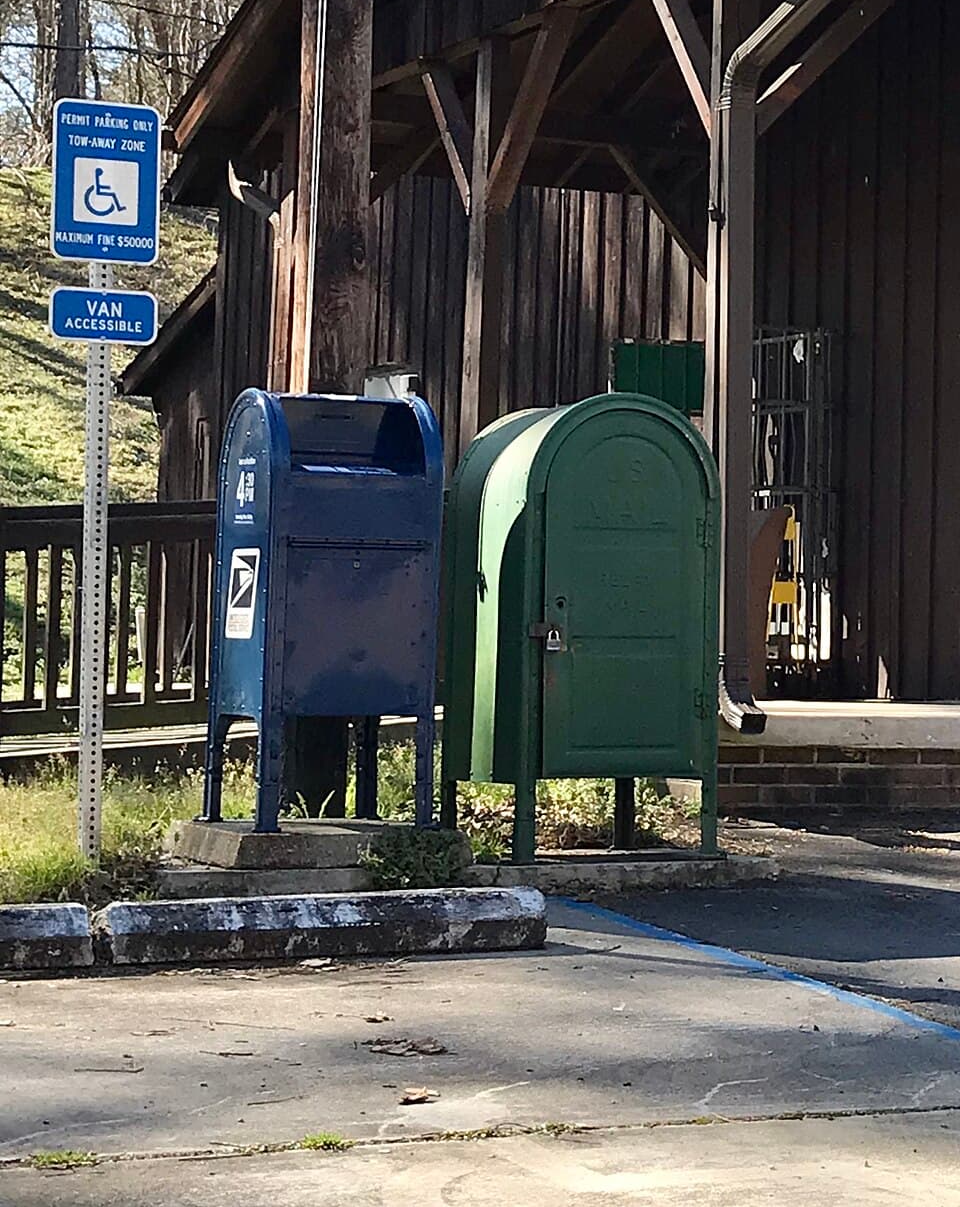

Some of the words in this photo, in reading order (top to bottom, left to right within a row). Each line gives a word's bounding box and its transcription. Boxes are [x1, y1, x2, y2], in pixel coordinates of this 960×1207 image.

[61, 113, 90, 126] PERMIT
[95, 116, 129, 129] PARKING
[133, 120, 154, 132] ONLY
[68, 134, 117, 149] TOW-AWAY
[121, 139, 146, 152] ZONE
[56, 232, 94, 245] MAXIMUM
[97, 234, 116, 246] FINE
[86, 299, 123, 318] VAN
[64, 318, 142, 333] ACCESSIBLE
